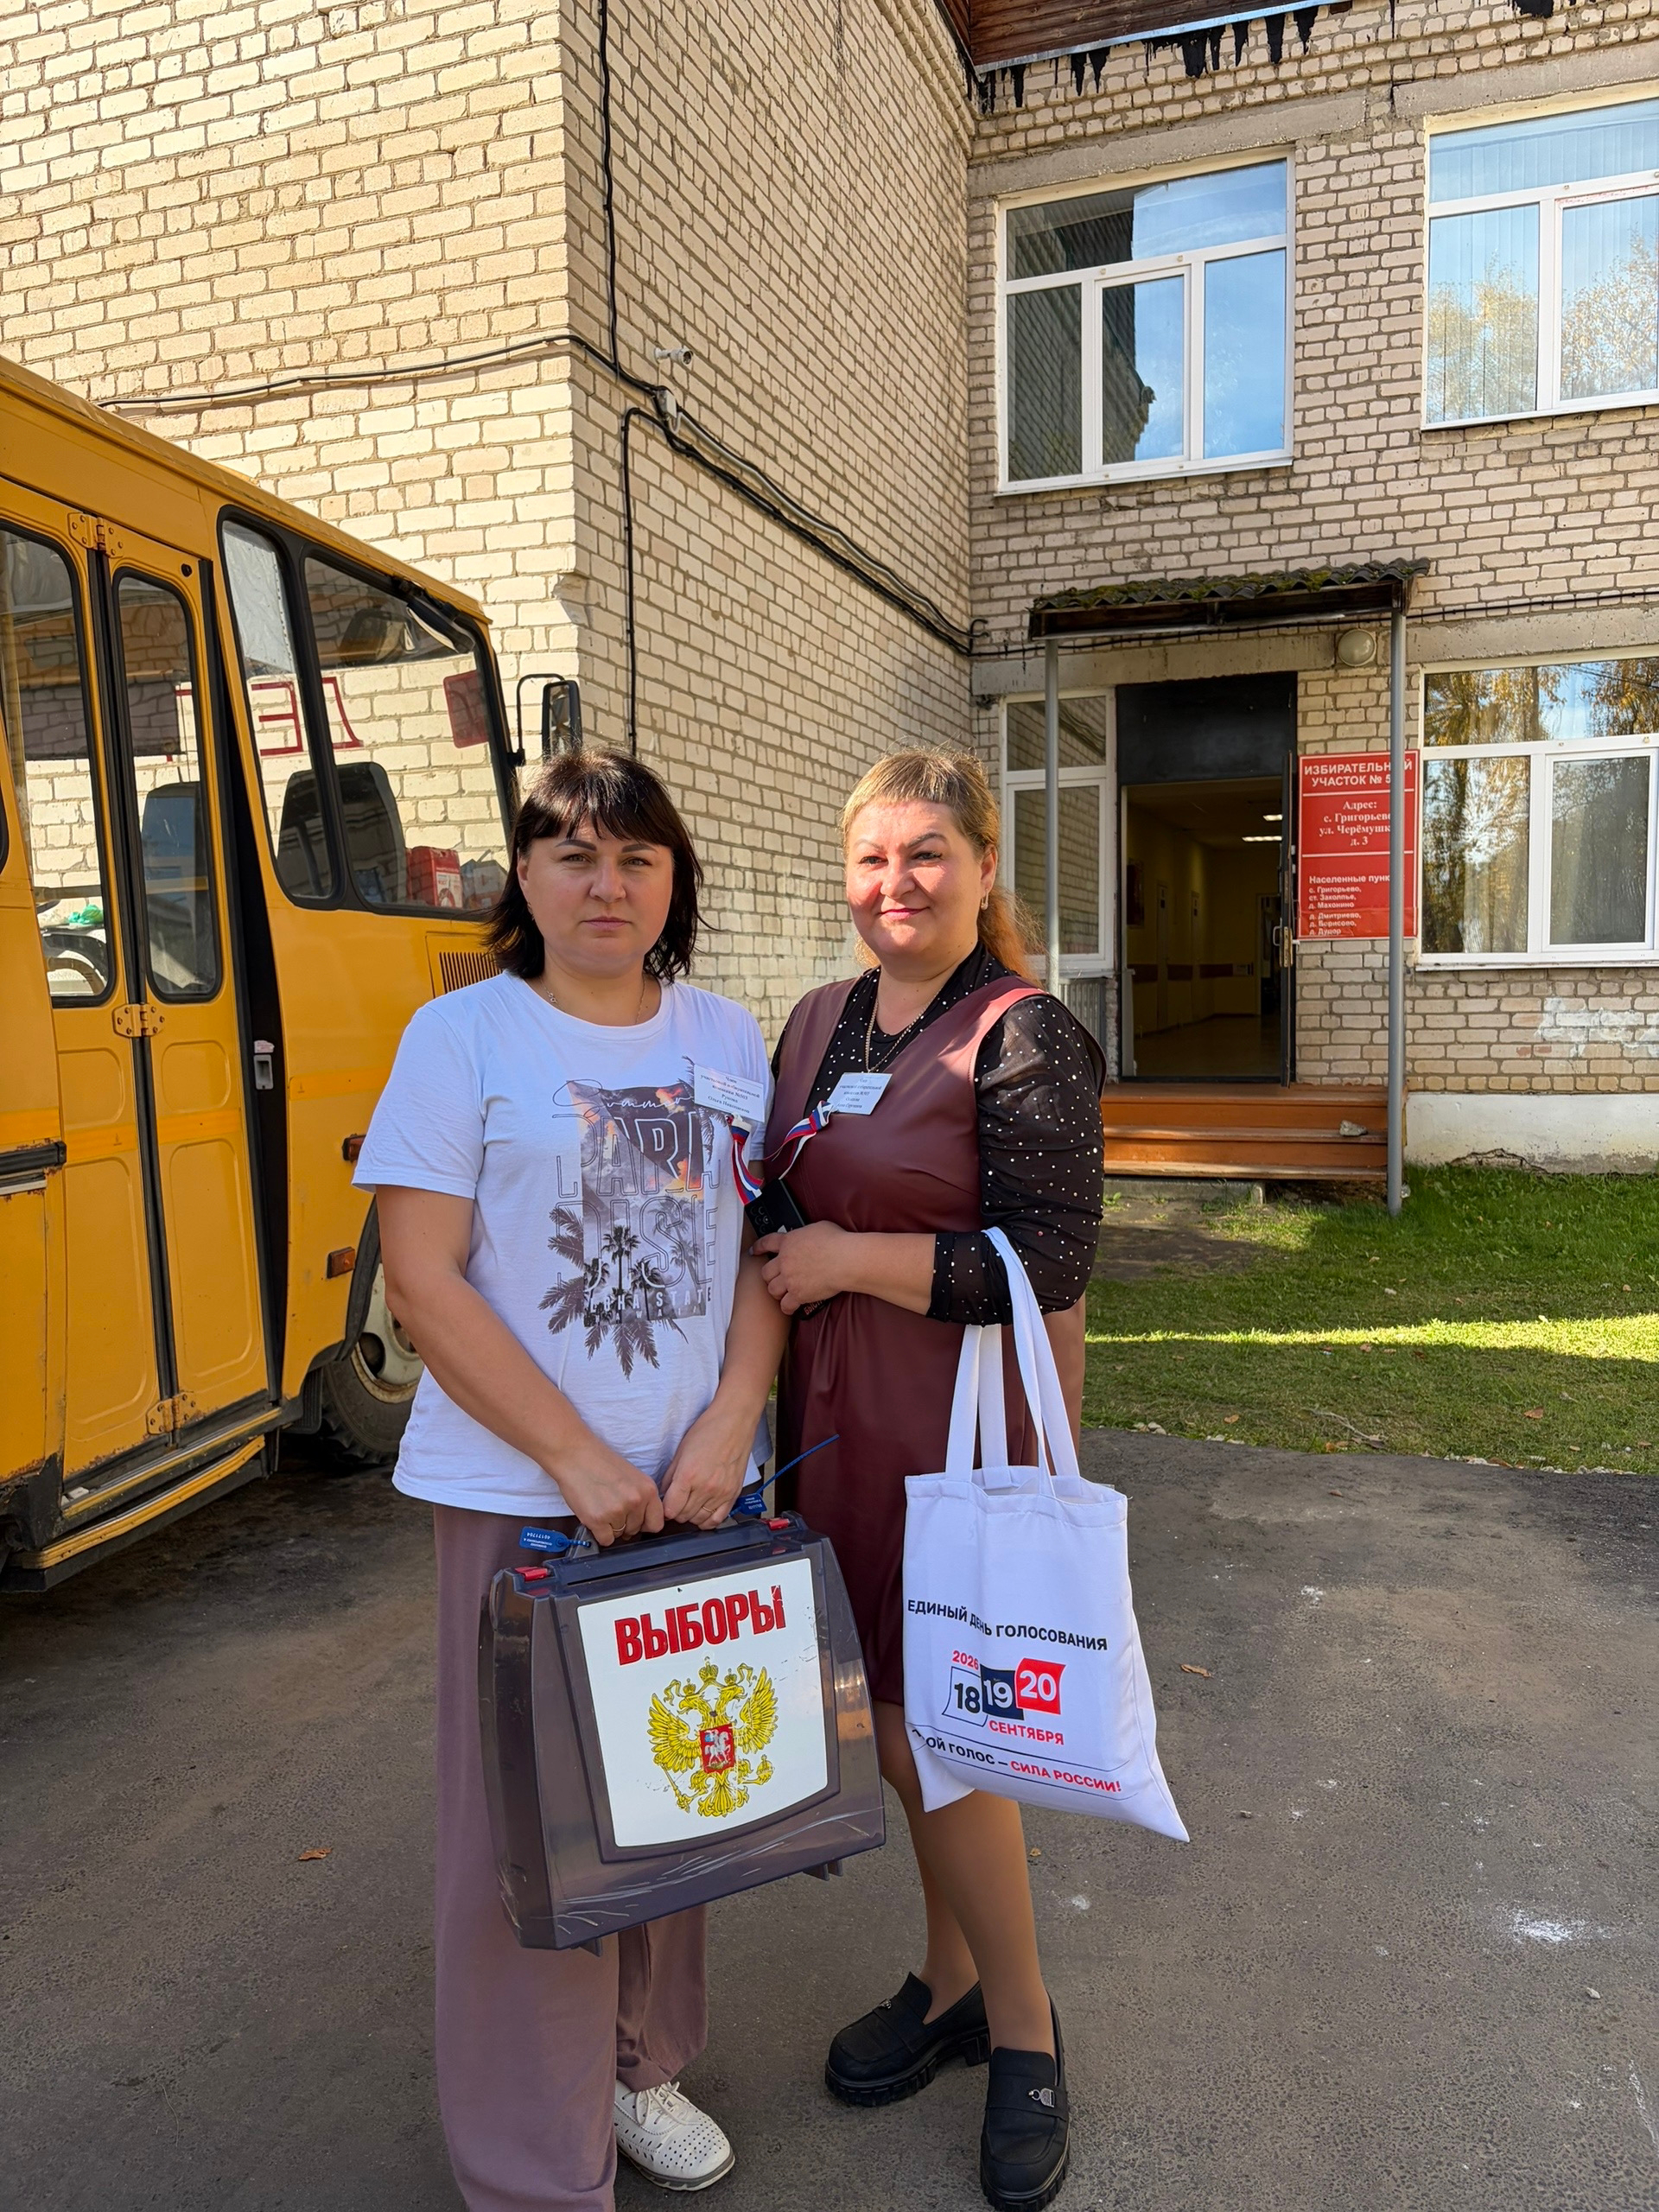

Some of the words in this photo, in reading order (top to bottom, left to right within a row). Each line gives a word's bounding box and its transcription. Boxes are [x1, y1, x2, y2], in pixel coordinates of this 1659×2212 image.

[1304, 759, 1413, 775] ИЗБИРАТЕЛЬНЙ
[1312, 775, 1366, 787] УЧАСТОК
[1370, 774, 1382, 785] №
[1343, 801, 1377, 811] Адрес:
[1319, 828, 1334, 837] ул.
[1337, 824, 1391, 836] Черёмушк
[1350, 838, 1360, 847] д.
[1362, 836, 1369, 846] 3
[1309, 874, 1367, 884] Населенные
[1368, 874, 1391, 884] пунк
[614, 1585, 786, 1665] ВЫБОРЫ
[907, 1599, 968, 1623] ЕДИНЫЙ
[969, 1612, 992, 1636] ДЕНЬ
[995, 1624, 1108, 1651] ГОЛОСОВАНИЯ
[951, 1649, 980, 1670] 2026
[954, 1682, 981, 1714] 18
[983, 1678, 1014, 1709] 19
[1019, 1669, 1057, 1701] 20
[988, 1719, 1065, 1746] СЕНТЯБРЯ
[949, 1743, 995, 1765] ГОЛОС
[1010, 1760, 1051, 1778] СИЛА
[1053, 1770, 1122, 1792] РОССИИ!
